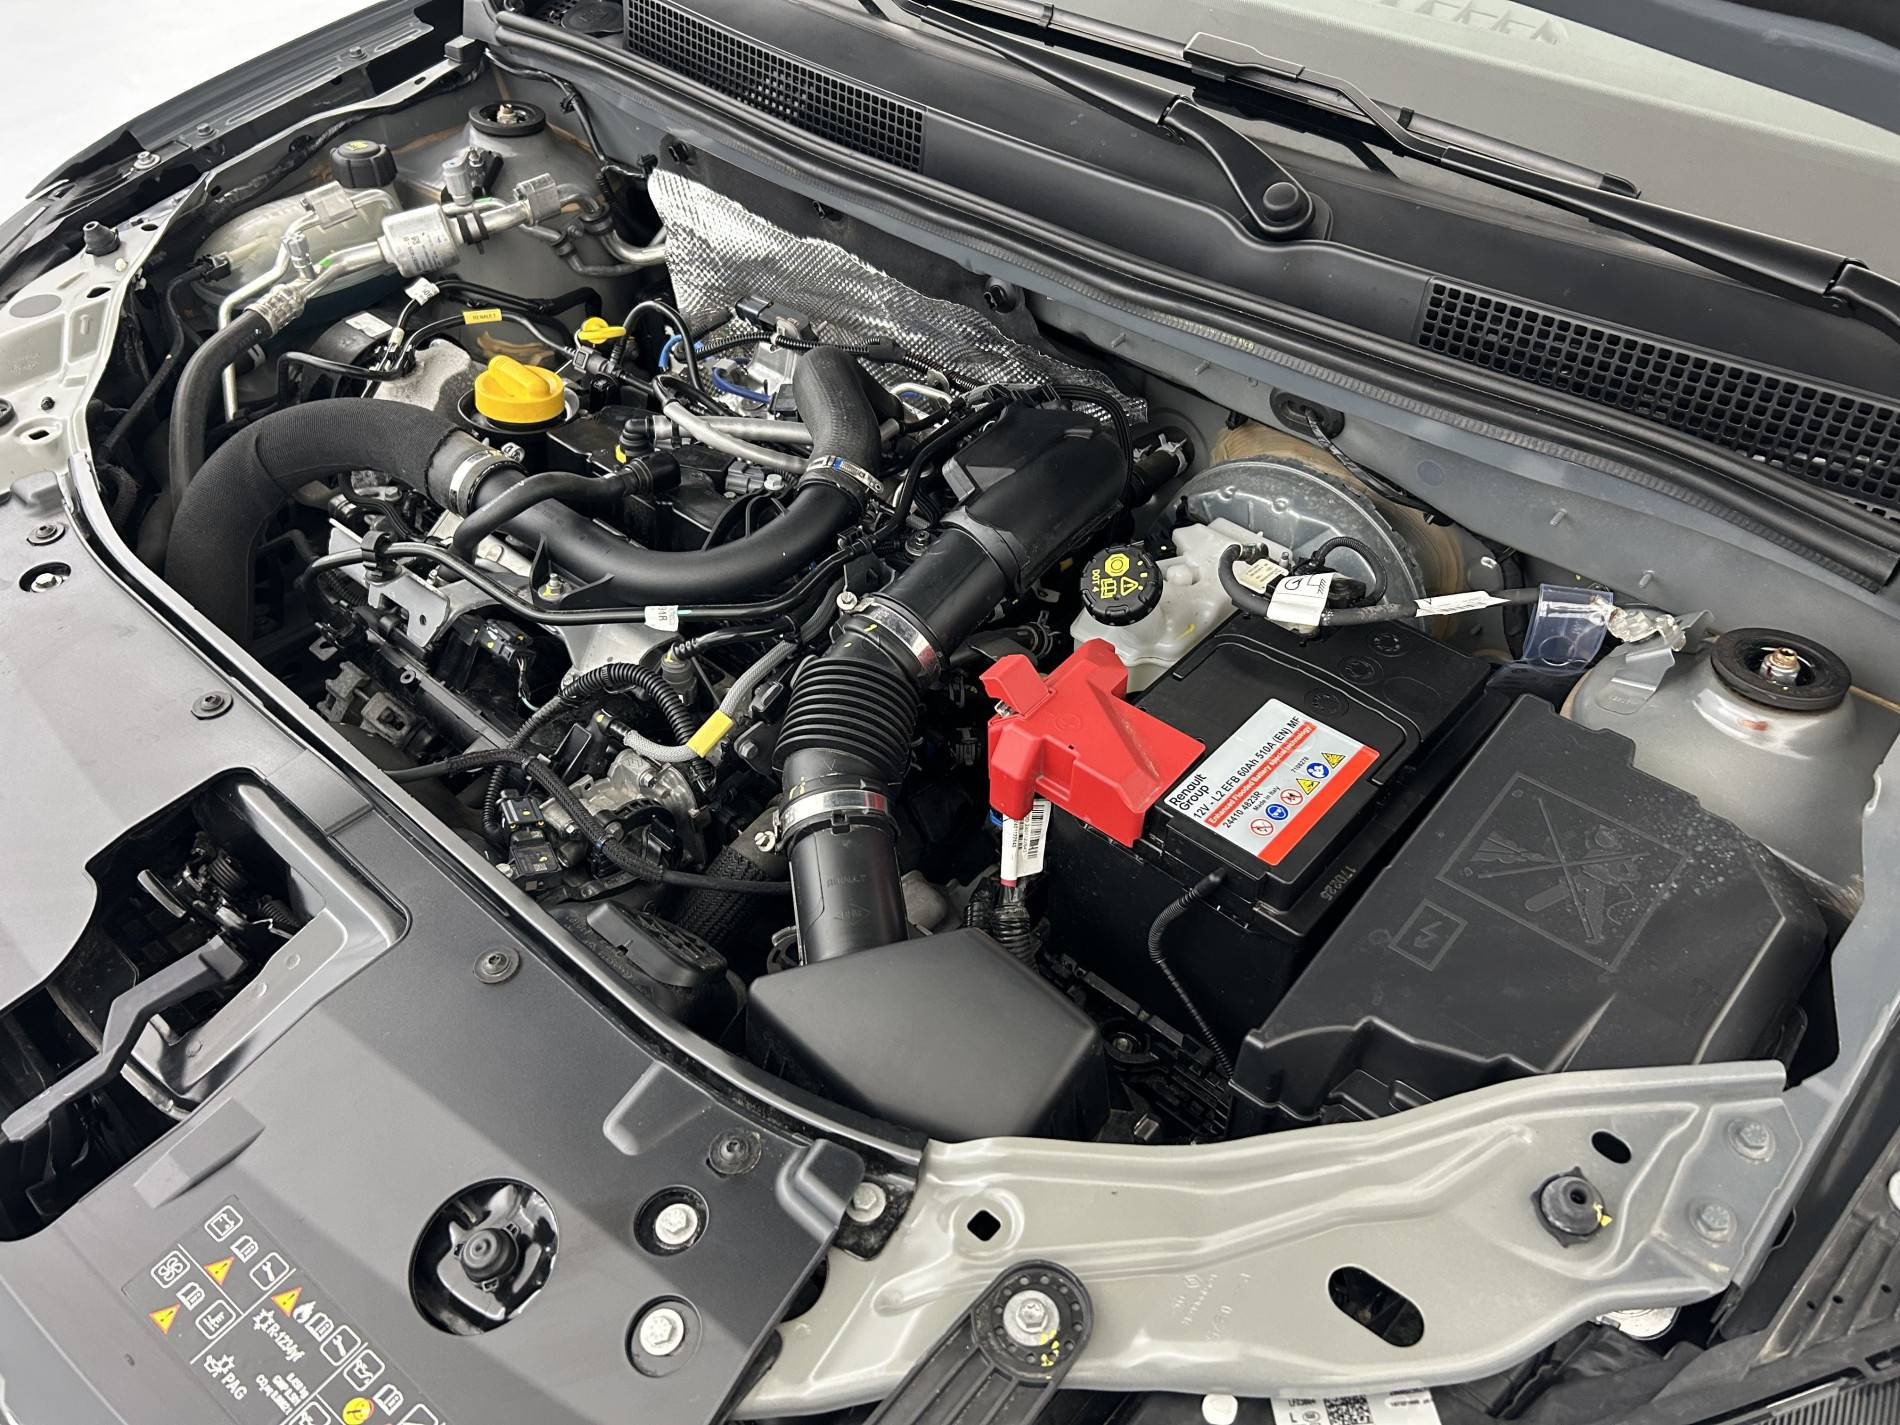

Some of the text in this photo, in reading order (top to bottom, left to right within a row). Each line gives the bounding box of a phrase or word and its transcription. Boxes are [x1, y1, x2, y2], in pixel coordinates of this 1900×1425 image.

[1092, 569, 1101, 585] DOT
[1193, 804, 1209, 820] 12V
[1211, 790, 1225, 802] L2
[1222, 776, 1240, 792] EFB
[1237, 758, 1258, 778] 60Ah
[1255, 742, 1276, 760] 510A
[1272, 726, 1291, 745] (EN)
[1288, 716, 1300, 730] MF
[1208, 725, 1311, 824] Enhanced Flooded Battery special technology
[1169, 776, 1206, 806] Renault
[1179, 784, 1212, 812] Group
[1253, 799, 1266, 812] Made
[1270, 786, 1280, 796] Italy
[1223, 791, 1262, 829] 24410 4823R
[266, 1322, 305, 1362] R-1234yf
[222, 1372, 248, 1400] PAG
